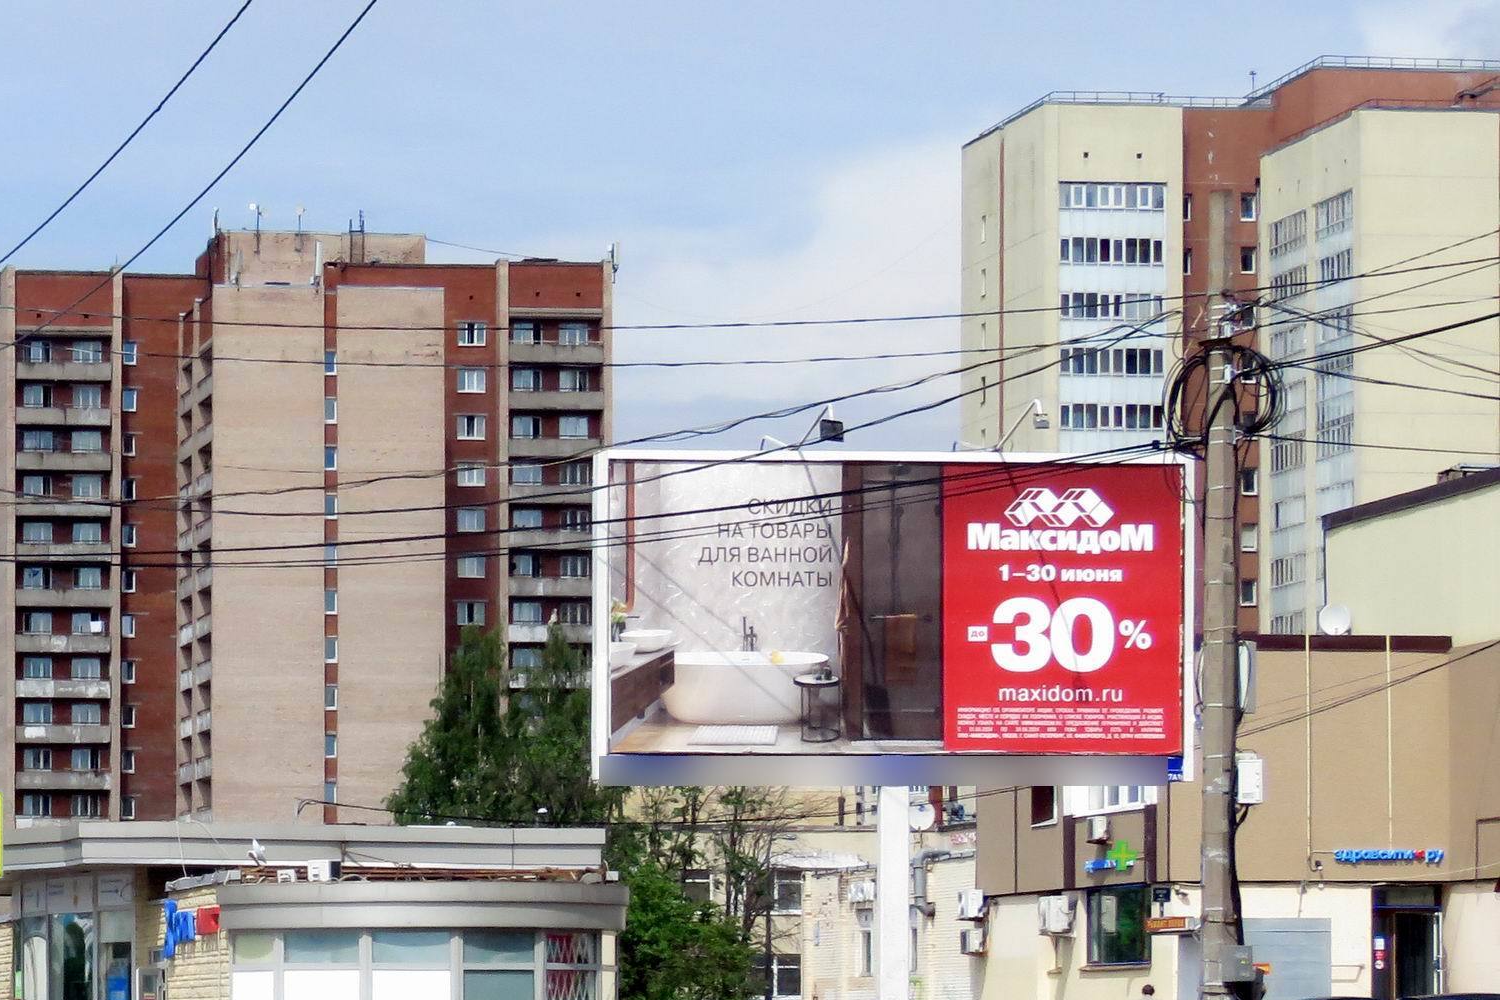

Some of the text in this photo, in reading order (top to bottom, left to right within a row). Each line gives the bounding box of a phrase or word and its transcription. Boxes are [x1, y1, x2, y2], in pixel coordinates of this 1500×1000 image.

[748, 498, 832, 517] СКИДКИ
[717, 523, 832, 539] НА ТОВАРЫ
[698, 544, 832, 565] ДЛЯ ВАННОЙ
[732, 571, 832, 587] КОМНАТЫ
[1061, 568, 1123, 582] июня
[999, 686, 1123, 702] maxidom.ru
